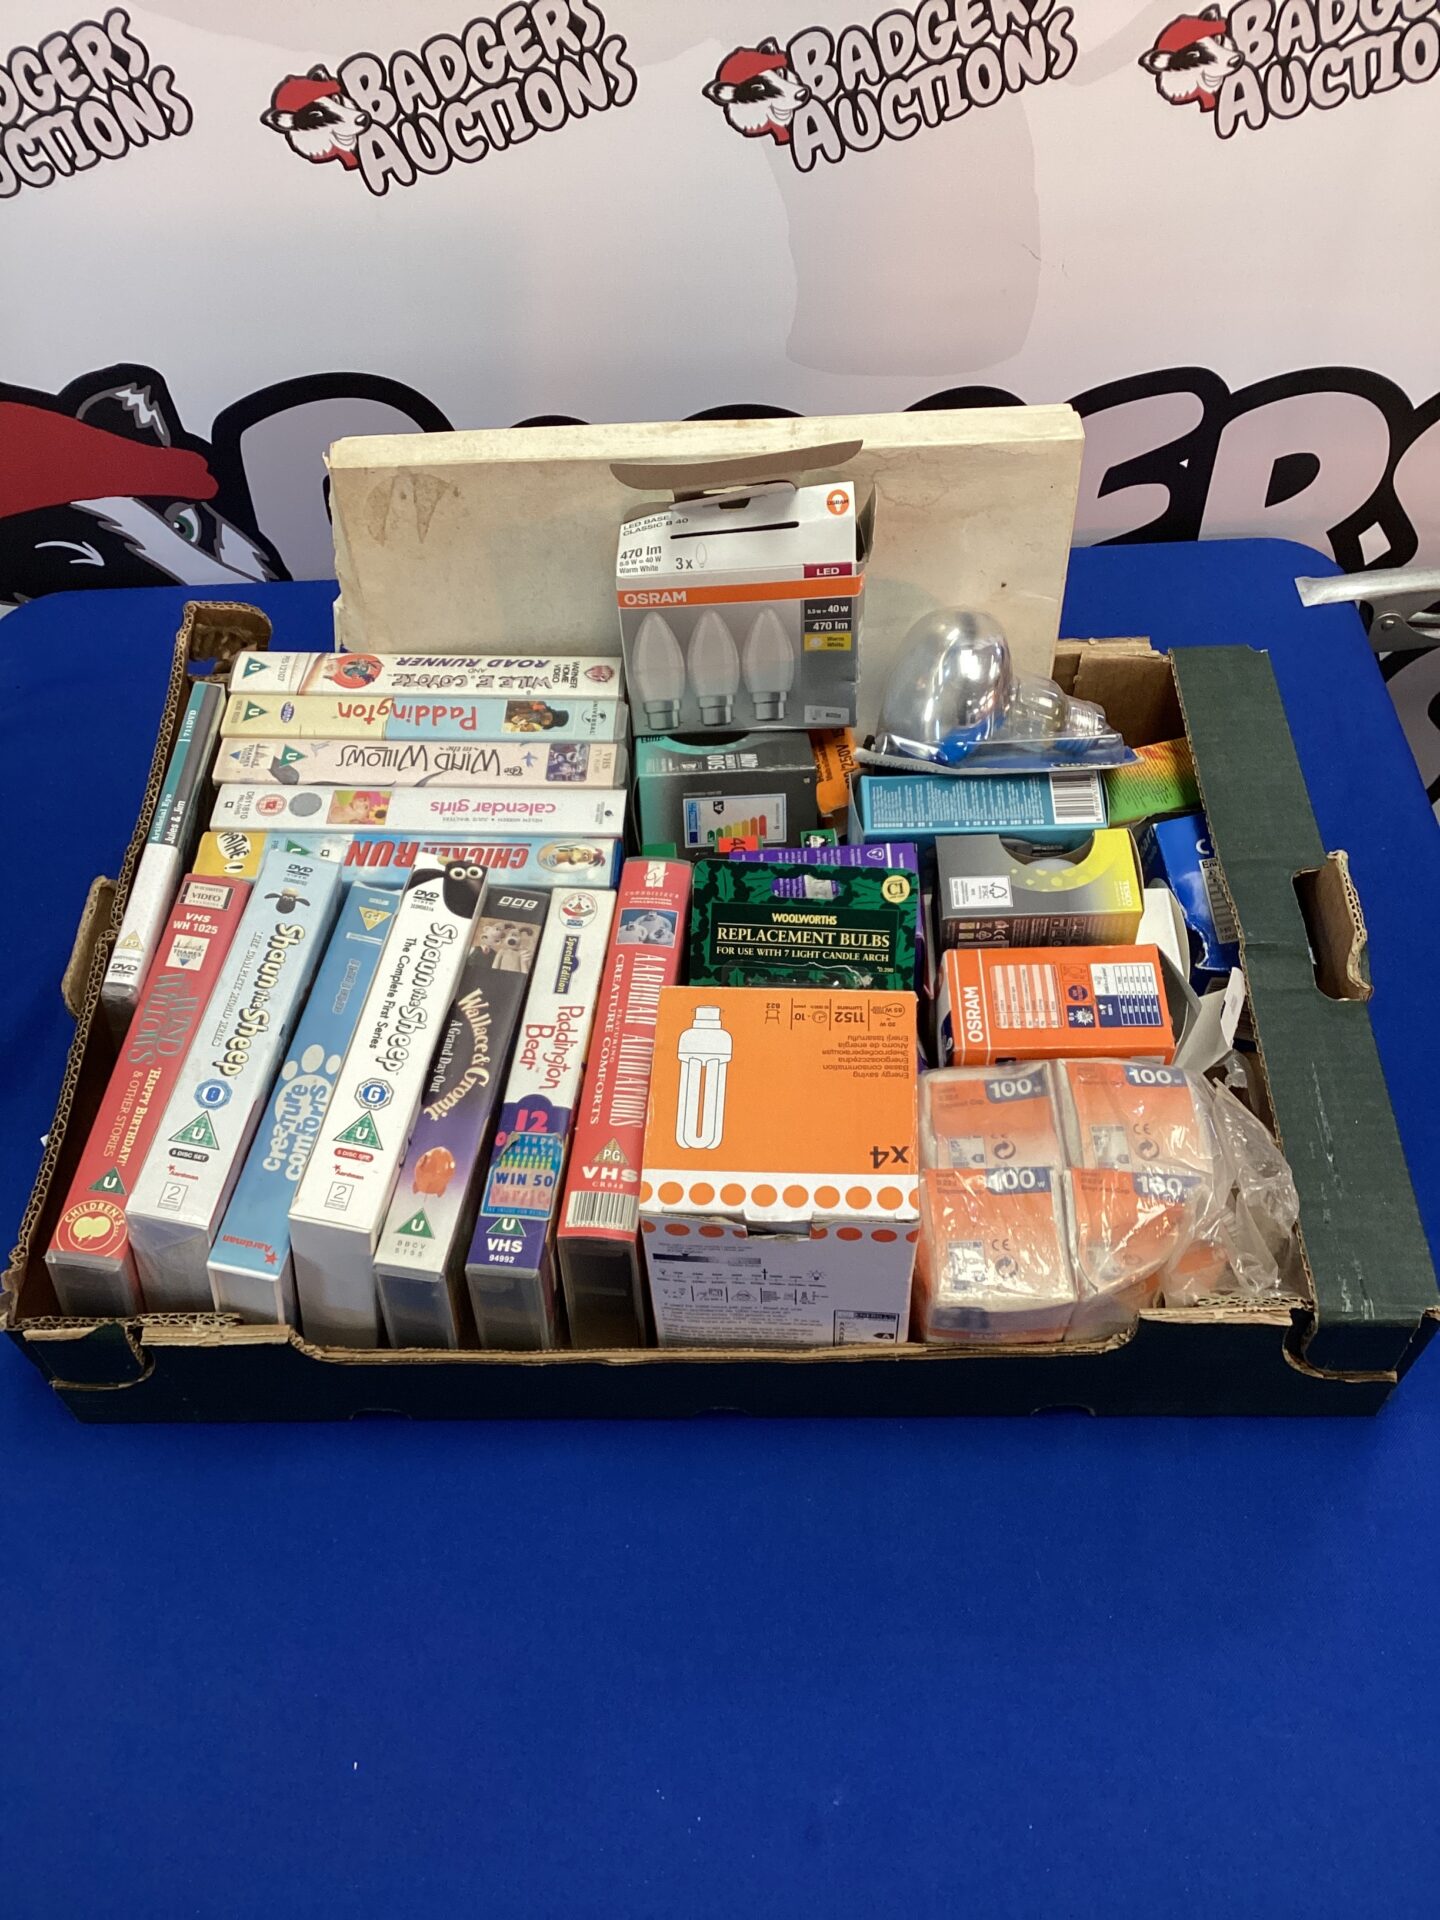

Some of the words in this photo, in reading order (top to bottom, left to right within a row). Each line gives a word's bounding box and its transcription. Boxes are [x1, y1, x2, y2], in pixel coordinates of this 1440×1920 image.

[340, 0, 605, 127] BADGERS
[791, 6, 1078, 173] AUCTIONS
[357, 34, 637, 196] AUCTIONS
[622, 522, 663, 537] CLASSIC
[623, 520, 642, 531] LED
[643, 515, 670, 525] BASE
[620, 547, 643, 560] 470
[646, 545, 662, 556] lm
[640, 565, 659, 573] White
[816, 566, 840, 576] LED
[624, 591, 687, 605] OSRAM
[827, 604, 839, 613] 40
[813, 621, 833, 631] 470
[835, 620, 848, 630] lm
[249, 663, 261, 671] U
[396, 657, 481, 668] RUNNER
[487, 658, 550, 669] ROAD
[392, 673, 468, 689] COYOTE
[551, 663, 561, 684] VIDEO
[561, 664, 571, 684] HOME
[570, 661, 580, 689] WARNER
[499, 676, 553, 689] WILE
[248, 708, 260, 716] U
[337, 697, 477, 731] Paddington
[184, 710, 197, 737] 711DVD
[286, 752, 298, 760] U
[602, 751, 612, 770] VHS
[707, 754, 725, 770] 500
[739, 753, 759, 769] 40W
[504, 765, 524, 776] The
[430, 799, 470, 813] girls
[473, 800, 556, 813] calendar
[151, 807, 167, 842] Artificial
[162, 794, 172, 806] Eye
[164, 821, 179, 843] Jules
[174, 800, 186, 814] Jim
[344, 841, 421, 867] RUN
[288, 863, 314, 873] DVD
[192, 893, 221, 902] VIDEO
[414, 889, 440, 898] DVD
[1123, 880, 1133, 907] TESCO
[498, 896, 539, 910] BBC
[185, 912, 212, 922] VHS
[771, 912, 838, 926] WOOLWORTHS
[173, 920, 190, 930] WH
[193, 923, 218, 934] 1025
[401, 937, 417, 953] The
[716, 927, 837, 945] REPLACEMENT
[839, 932, 890, 948] BULBS
[173, 948, 202, 957] THAMES
[254, 922, 305, 989] Shaun
[411, 923, 459, 987] Shaun
[562, 936, 577, 966] Special
[716, 946, 735, 955] FOR
[737, 947, 754, 956] USE
[756, 948, 782, 957] WITH
[791, 950, 821, 959] LIGHT
[822, 951, 860, 961] CANDLE
[862, 953, 889, 962] ARCH
[110, 963, 138, 971] DVD
[386, 955, 411, 998] Complete
[557, 965, 572, 993] Edition
[249, 988, 270, 1010] the
[409, 987, 427, 1007] the
[604, 953, 625, 1033] CREATURE
[380, 1000, 396, 1018] First
[794, 1012, 805, 1021] 10
[834, 1011, 865, 1023] 1152
[962, 985, 985, 1043] OSRAM
[450, 1019, 463, 1027] A
[458, 987, 492, 1053] Wallace
[212, 1008, 270, 1077] Sheep
[369, 1021, 389, 1049] Series
[375, 1005, 428, 1073] Sheep
[441, 1028, 461, 1057] Grand
[609, 1008, 623, 1064] FEATURING
[886, 1034, 909, 1042] Enerji
[519, 1024, 556, 1071] Bear
[538, 1005, 586, 1090] Paddington
[434, 1056, 452, 1075] Day
[472, 1053, 490, 1066] &
[429, 1074, 446, 1093] Out
[590, 1036, 612, 1126] COMFORTS
[1129, 1067, 1172, 1084] 100
[367, 1086, 382, 1102] G
[423, 1065, 490, 1122] Gromit
[989, 1078, 1033, 1099] 100
[121, 1079, 142, 1117] OTHER
[515, 1109, 548, 1133] 12
[103, 1115, 127, 1158] STORIES
[191, 1126, 205, 1140] U
[355, 1126, 369, 1140] U
[177, 1150, 193, 1159] DISC
[193, 1152, 207, 1161] SET
[602, 1149, 621, 1161] PG
[869, 1145, 909, 1169] x4
[103, 1176, 117, 1189] U
[496, 1171, 528, 1185] WIN
[533, 1173, 554, 1187] 50
[582, 1166, 638, 1183] VHS
[987, 1169, 1036, 1191] 100
[167, 1185, 181, 1201] 2
[334, 1185, 347, 1200] 2
[411, 1219, 425, 1231] U
[502, 1218, 516, 1231] U
[223, 1235, 273, 1252] Aardman
[487, 1238, 523, 1253] VHS
[489, 1254, 515, 1264] 94992
